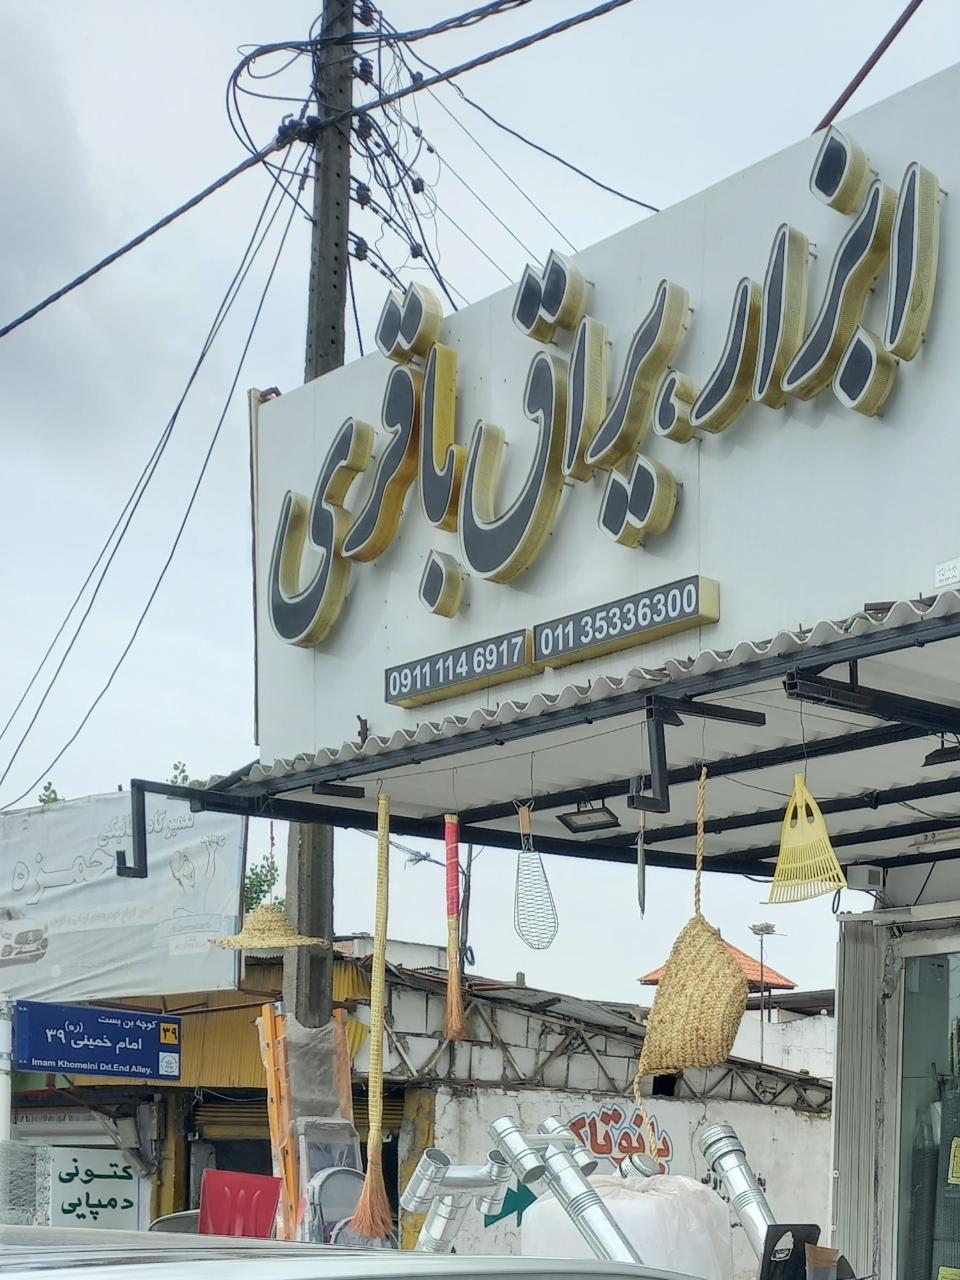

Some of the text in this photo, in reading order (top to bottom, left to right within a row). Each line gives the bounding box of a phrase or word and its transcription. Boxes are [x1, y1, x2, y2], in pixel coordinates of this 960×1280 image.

[690, 125, 940, 433] ابزار
[458, 249, 690, 584] یراق
[268, 281, 467, 648] باقری
[540, 583, 698, 656] 011 35336300
[473, 636, 523, 674] 6917
[12, 848, 115, 905] حمزه
[98, 1015, 158, 1032] کوچه بن بست
[162, 1026, 177, 1040] ۳۹
[45, 1028, 142, 1054] امام خمینی ۳۹
[31, 1057, 56, 1068] Imam
[57, 1060, 98, 1071] Khomeini
[58, 1158, 133, 1184] کتونی
[61, 1191, 134, 1220] دمپایی
